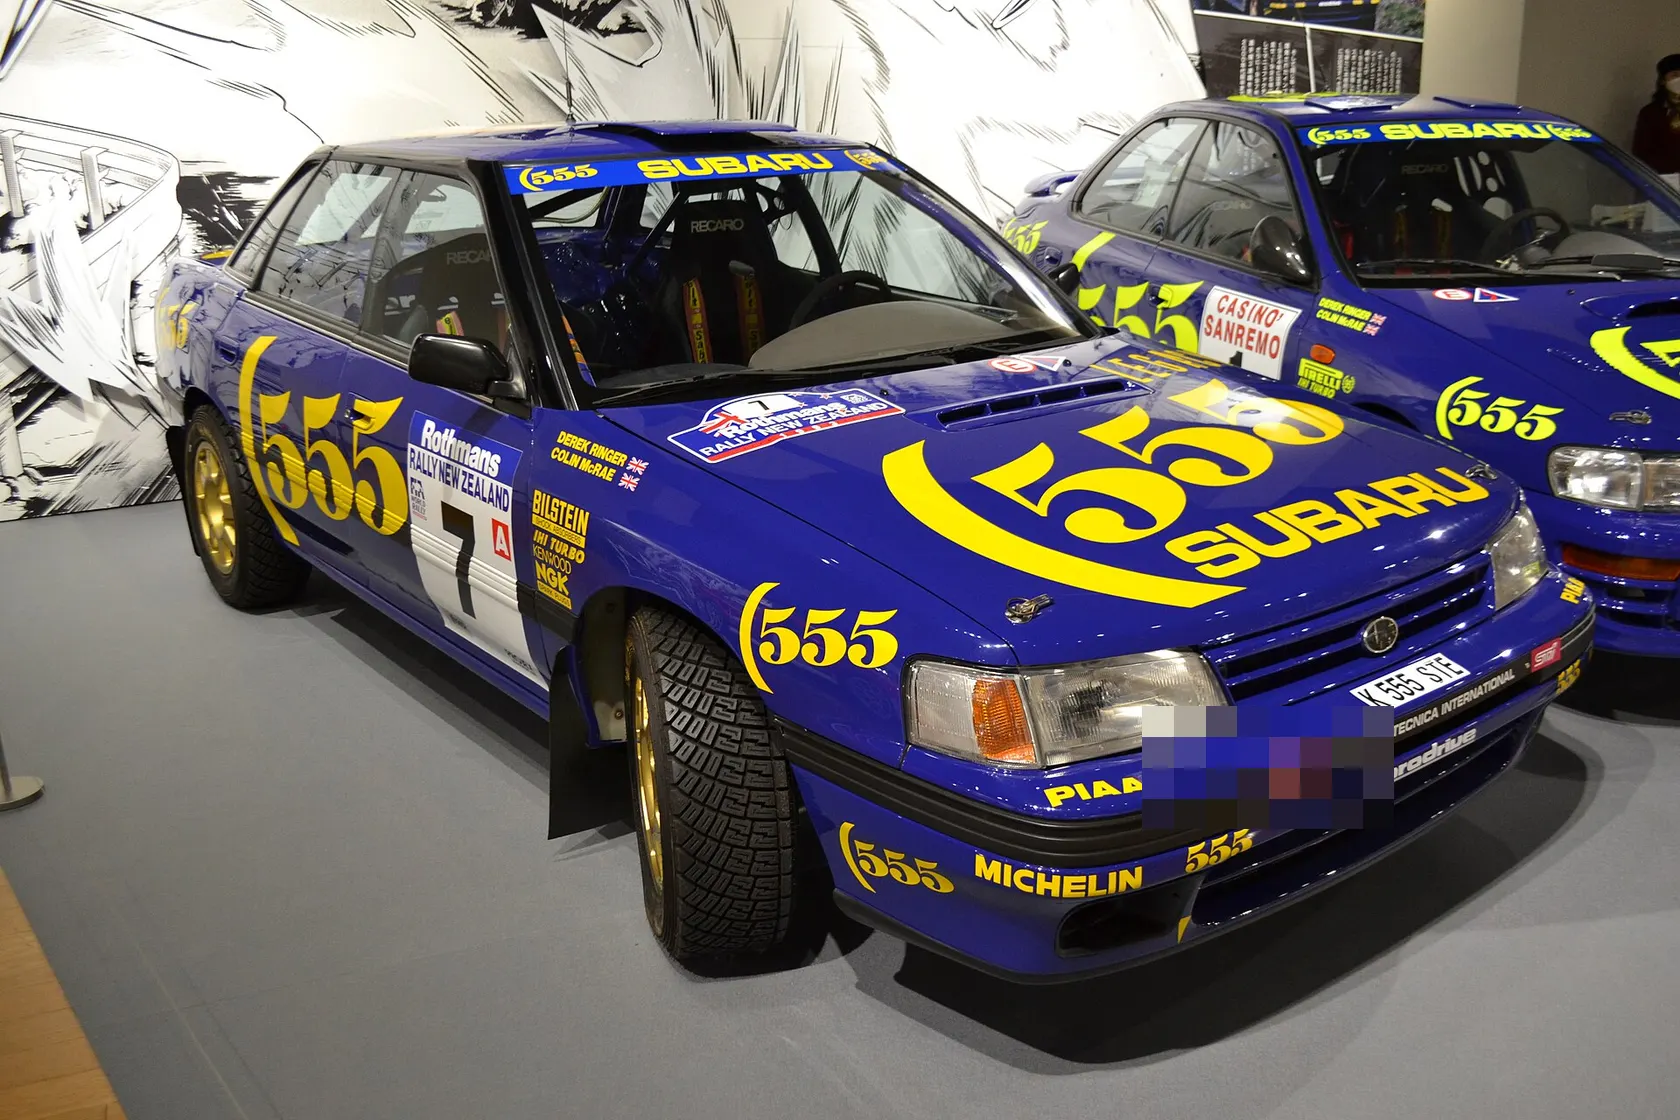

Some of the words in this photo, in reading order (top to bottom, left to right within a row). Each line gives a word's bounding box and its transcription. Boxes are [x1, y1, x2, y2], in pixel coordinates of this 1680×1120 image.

[1380, 123, 1551, 140] SUBARU
[637, 153, 833, 178] SUBARU
[1401, 163, 1449, 175] RECARO
[690, 218, 745, 234] RECARO
[1316, 309, 1340, 323] COLIN
[1318, 297, 1345, 312] DEREK
[1342, 304, 1373, 321] RINGER
[1204, 314, 1280, 359] SANREMO
[1298, 357, 1344, 390] PIRELLI
[1309, 381, 1336, 399] TURBO
[714, 402, 846, 438] Rothmans
[748, 400, 770, 411] 7
[699, 432, 756, 456] RALLY
[757, 420, 803, 436] NEW
[802, 402, 888, 424] ZEALAND
[421, 419, 501, 477] Rothmans
[550, 447, 581, 468] COLIN
[578, 457, 616, 482] McRAE
[556, 430, 592, 453] DEREK
[588, 442, 628, 467] RINGER
[409, 447, 438, 479] RALLY
[439, 459, 460, 489] NEW
[461, 469, 510, 513] ZEALAND
[532, 489, 590, 536] BILSTEIN
[1164, 465, 1490, 579] SUBARU
[495, 523, 510, 558] A
[533, 529, 549, 546] IHI
[550, 537, 585, 564] TURBO
[535, 516, 551, 530] SHOCK
[552, 525, 582, 545] ABSORBERS
[441, 500, 476, 619] 7
[532, 543, 572, 574] KENWOOD
[534, 559, 569, 596] NGK
[1559, 577, 1585, 605] PIAA
[1375, 672, 1425, 701] 555
[1416, 656, 1464, 683] STE
[1394, 707, 1439, 737] TECNICA
[1441, 669, 1515, 716] INTERNATIONAL
[1184, 828, 1253, 873] 555
[975, 854, 1143, 899] MICHELIN
